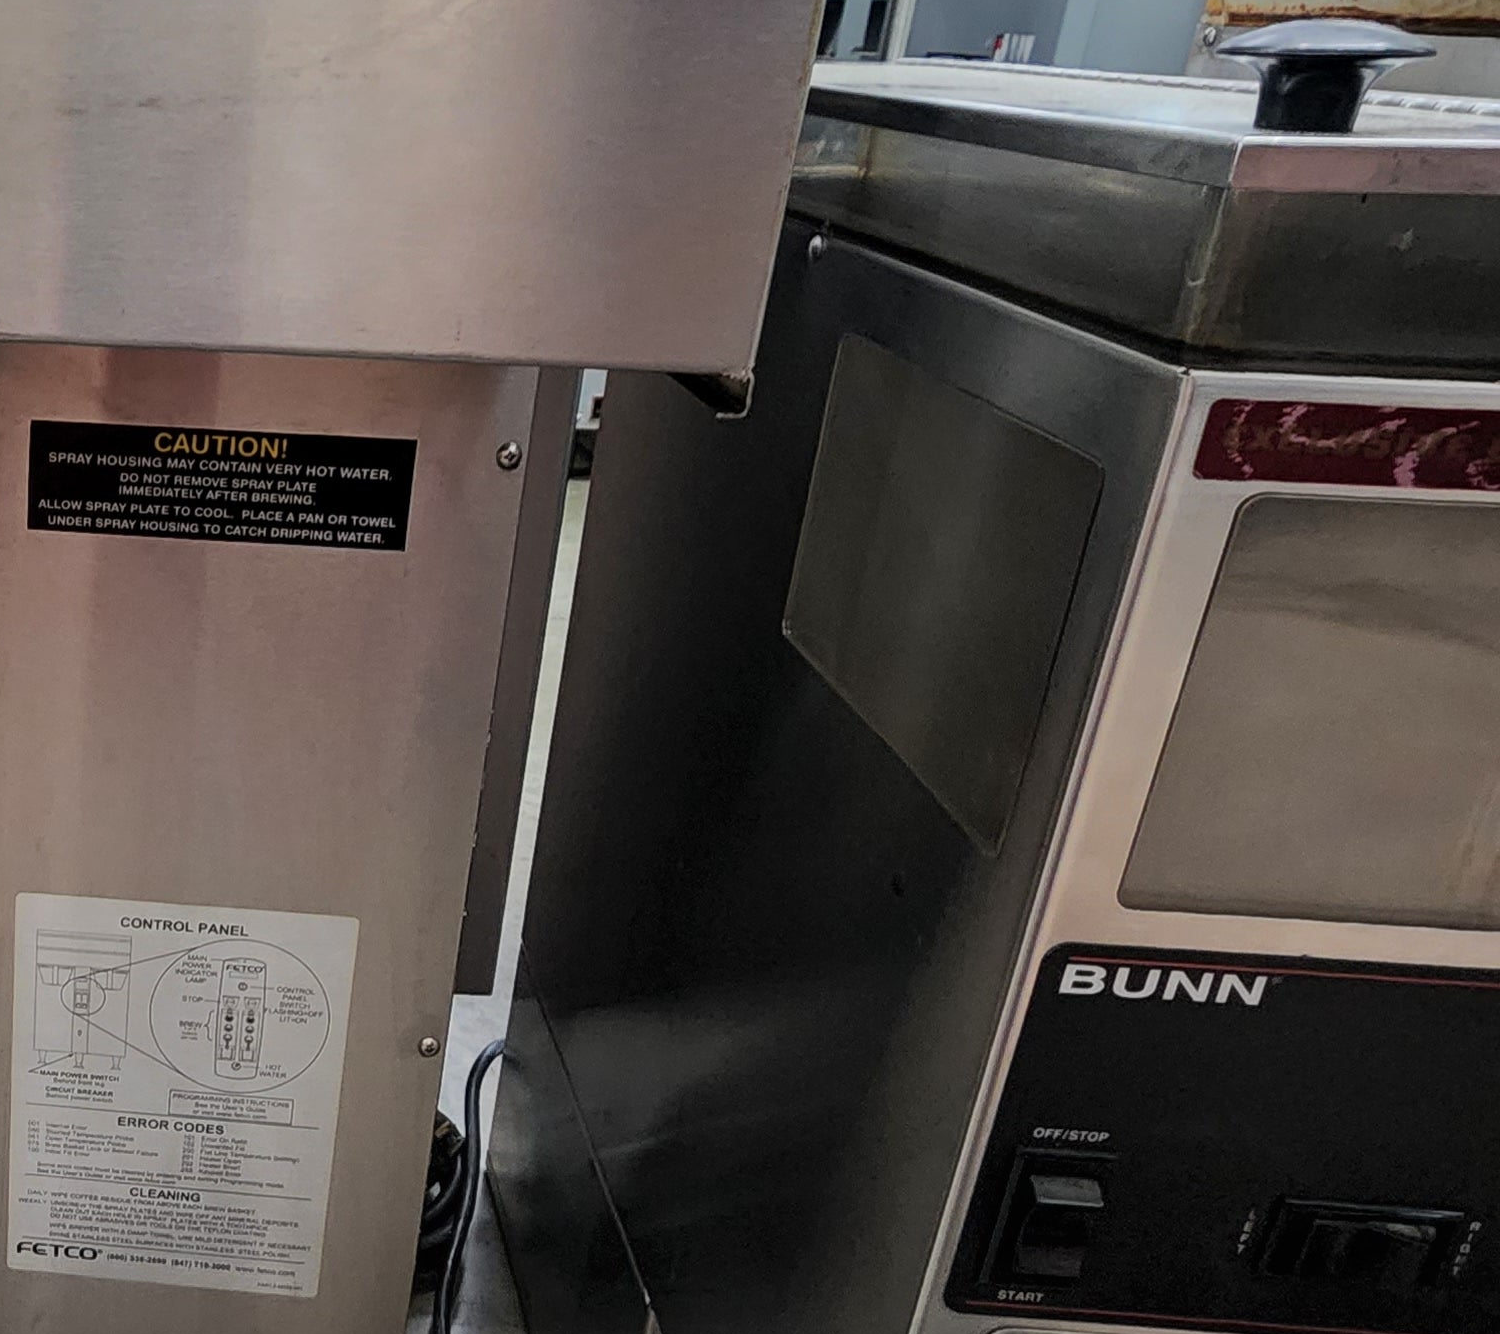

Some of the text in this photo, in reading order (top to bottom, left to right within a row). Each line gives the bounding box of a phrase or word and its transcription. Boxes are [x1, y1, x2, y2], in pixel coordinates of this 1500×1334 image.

[154, 432, 287, 458] CAUTION!
[48, 451, 92, 464] SPRAY
[97, 453, 161, 467] HOUSING
[167, 457, 195, 468] MAY
[199, 458, 261, 472] CONTAIN
[266, 463, 302, 476] VERY
[306, 465, 336, 477] HOT
[119, 472, 317, 491] DO NOT REMOVE SPRAY PLATE
[118, 485, 200, 498] IMMEDIATELY
[205, 489, 247, 500] AFTER
[38, 498, 82, 510] ALLOW
[85, 500, 127, 512] SPRAY
[130, 502, 169, 514] PLATE
[173, 504, 190, 515] TO
[241, 509, 283, 521] PLACE
[286, 511, 295, 522] A
[298, 511, 324, 523] PAN
[327, 513, 347, 524] OR
[351, 514, 396, 526] TOWEL
[48, 515, 92, 527] UNDER
[95, 518, 136, 529] SPRAY
[140, 520, 199, 533] HOUSING
[203, 524, 220, 535] TO
[224, 525, 267, 537] CATCH
[270, 528, 333, 541] DRIPPING
[120, 916, 248, 936] CONTROL PANEL
[1058, 963, 1268, 1006] BUNN
[117, 1116, 224, 1134] ERROR CODES
[1033, 1127, 1111, 1142] OFF/STOP
[129, 1187, 200, 1202] CLEANING
[16, 1240, 97, 1260] FETCO
[997, 1290, 1044, 1303] START
